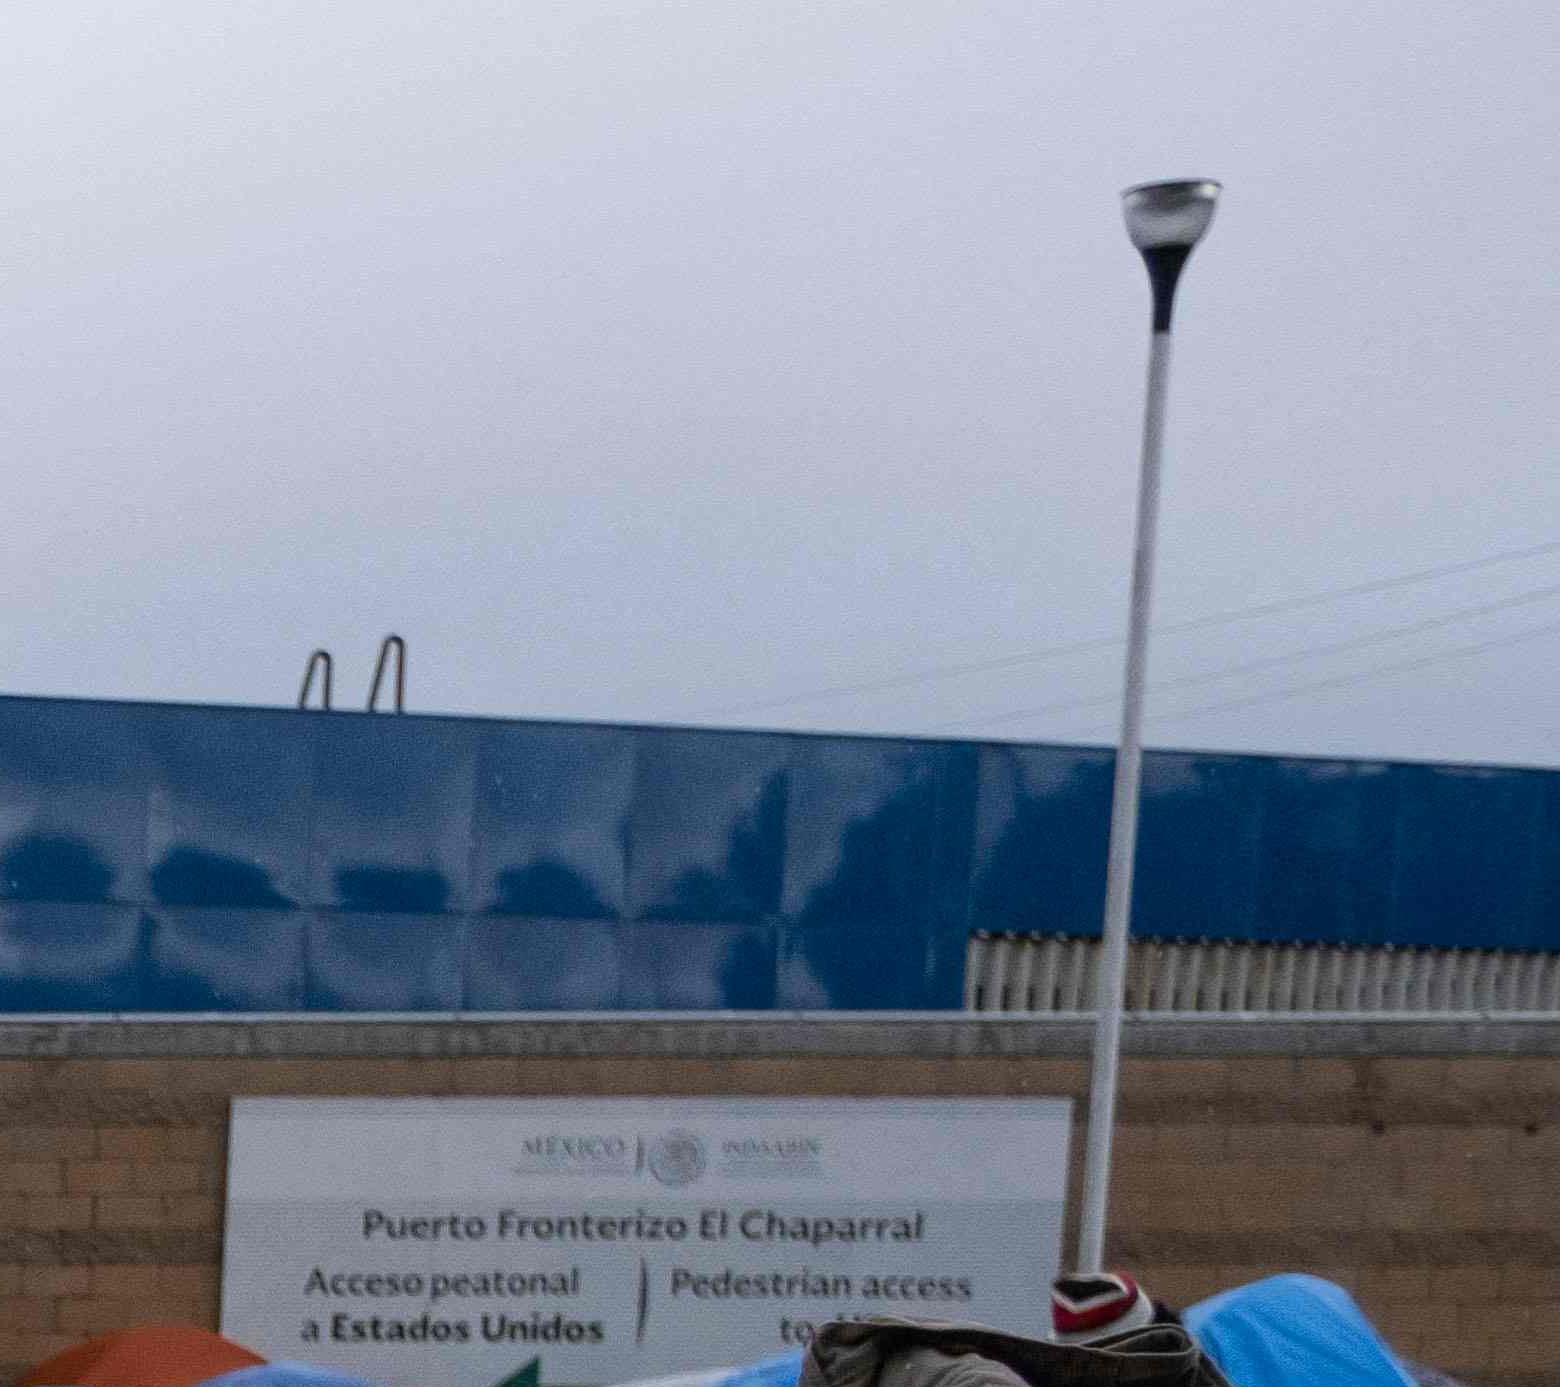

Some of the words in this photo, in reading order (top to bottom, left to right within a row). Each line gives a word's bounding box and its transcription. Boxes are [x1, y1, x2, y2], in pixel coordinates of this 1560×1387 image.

[361, 1207, 488, 1240] Puerto
[497, 1207, 688, 1241] Fronterizo
[698, 1207, 728, 1241] El
[739, 1208, 925, 1247] Chaparral
[303, 1265, 423, 1297] Acceso
[430, 1267, 580, 1302] peatonal
[670, 1266, 852, 1299] Pedestrian
[861, 1273, 972, 1299] access
[299, 1320, 320, 1343] a
[329, 1312, 471, 1343] Estados
[480, 1310, 605, 1344] Unidos
[779, 1316, 815, 1344] to
